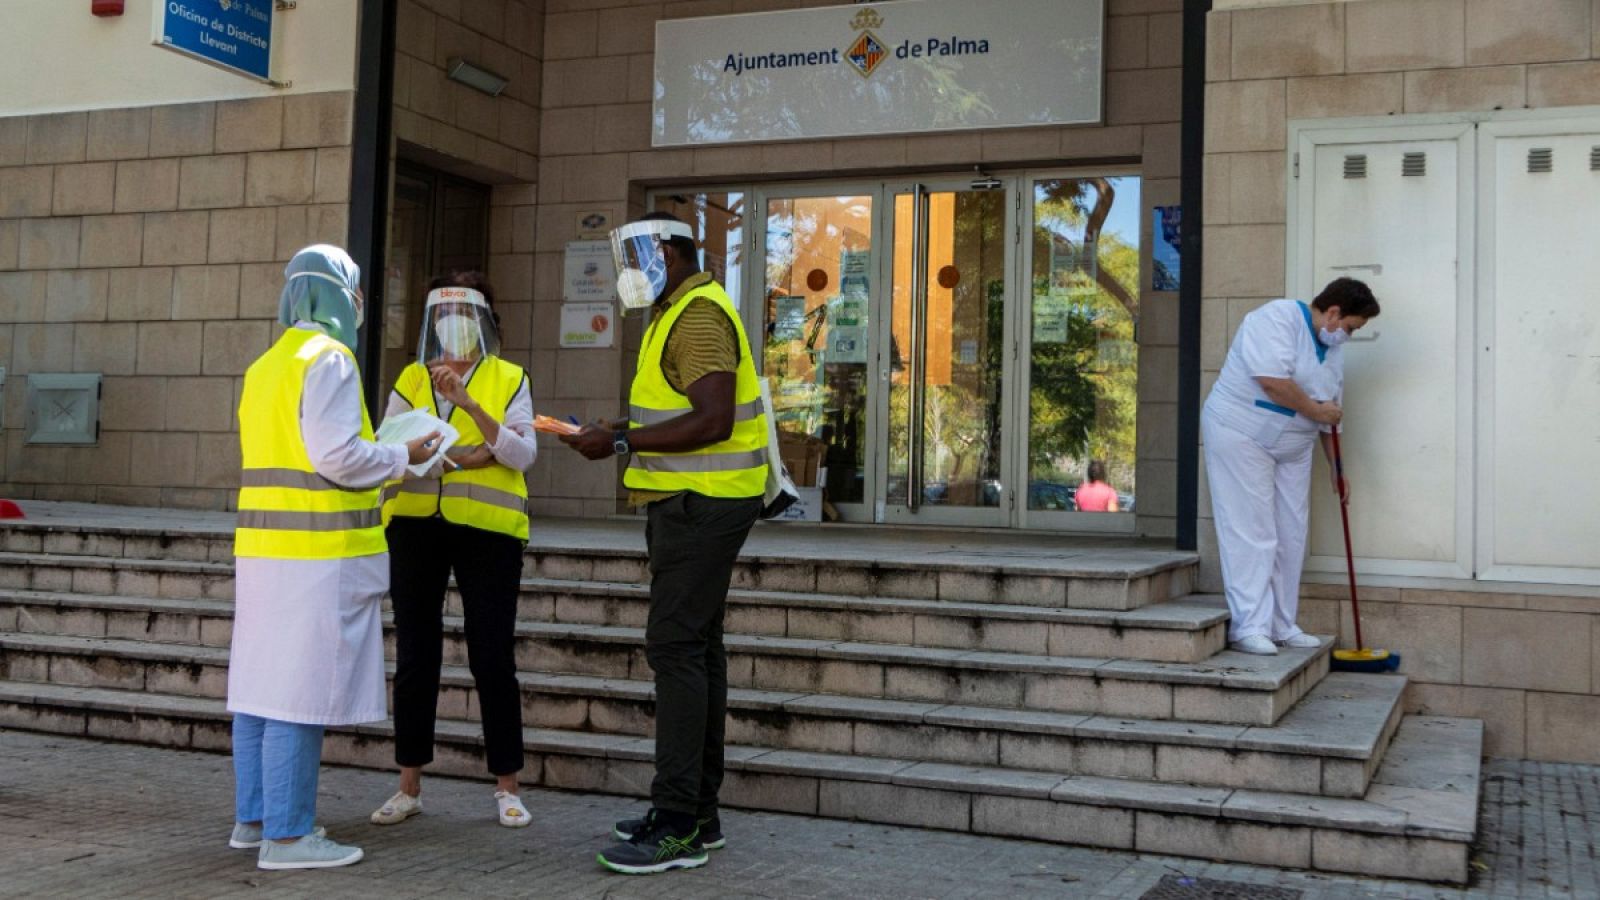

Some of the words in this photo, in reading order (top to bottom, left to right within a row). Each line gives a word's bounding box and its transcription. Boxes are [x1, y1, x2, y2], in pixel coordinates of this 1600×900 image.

[168, 2, 208, 27] Oficina
[211, 18, 225, 33] de
[227, 24, 268, 49] Districte
[200, 31, 237, 55] Llevant
[723, 48, 839, 76] Ajuntament
[895, 40, 923, 59] de
[927, 36, 990, 56] Palma
